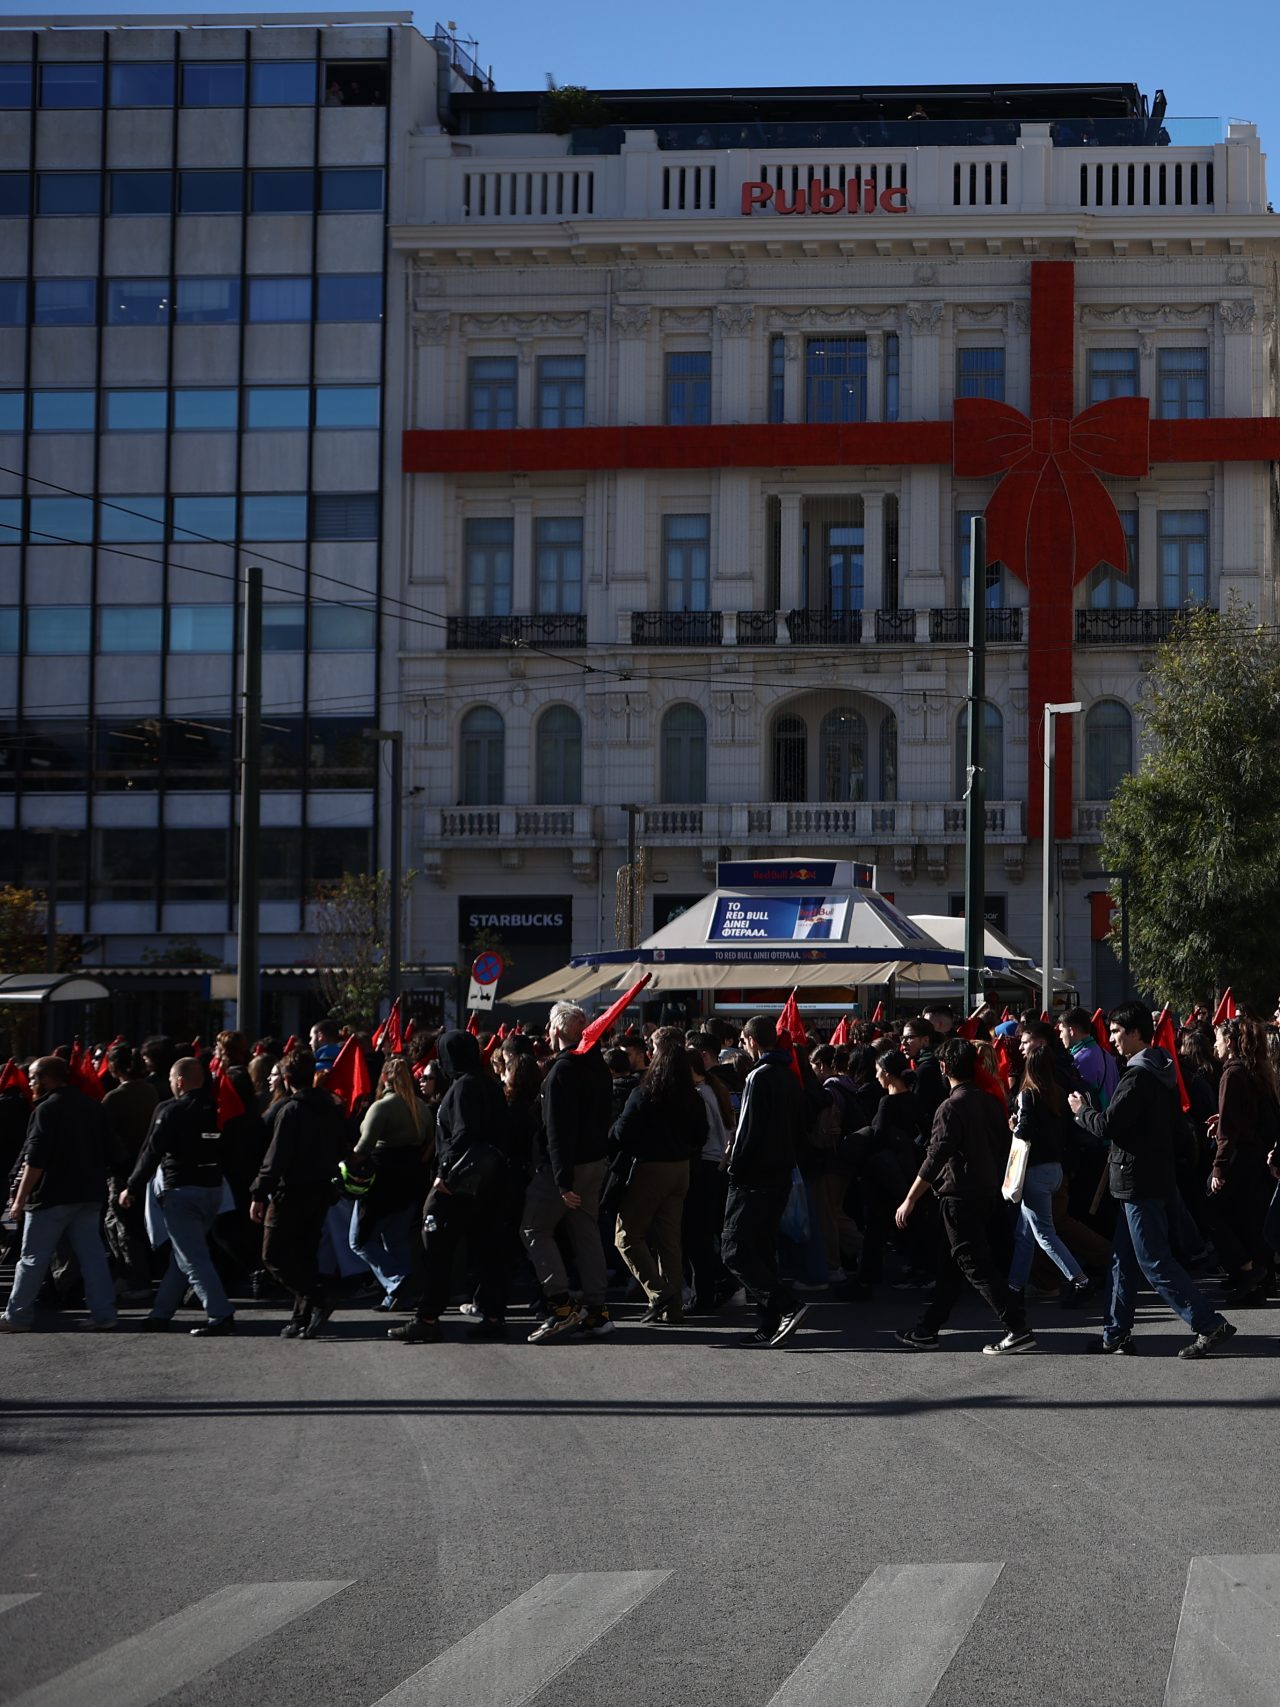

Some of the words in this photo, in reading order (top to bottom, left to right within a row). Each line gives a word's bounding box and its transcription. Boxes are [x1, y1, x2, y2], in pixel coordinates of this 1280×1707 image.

[741, 178, 908, 215] Public
[726, 911, 745, 920] RED
[746, 911, 769, 920] BULL
[469, 914, 563, 927] STARBUCKS
[723, 920, 750, 929] ΔΙΝΕΙ
[721, 928, 768, 937] ΦΤΕΡΑΑΑ.
[724, 951, 737, 960] RED
[737, 951, 753, 960] BULL
[753, 951, 770, 960] ΔΙΝΕΙ
